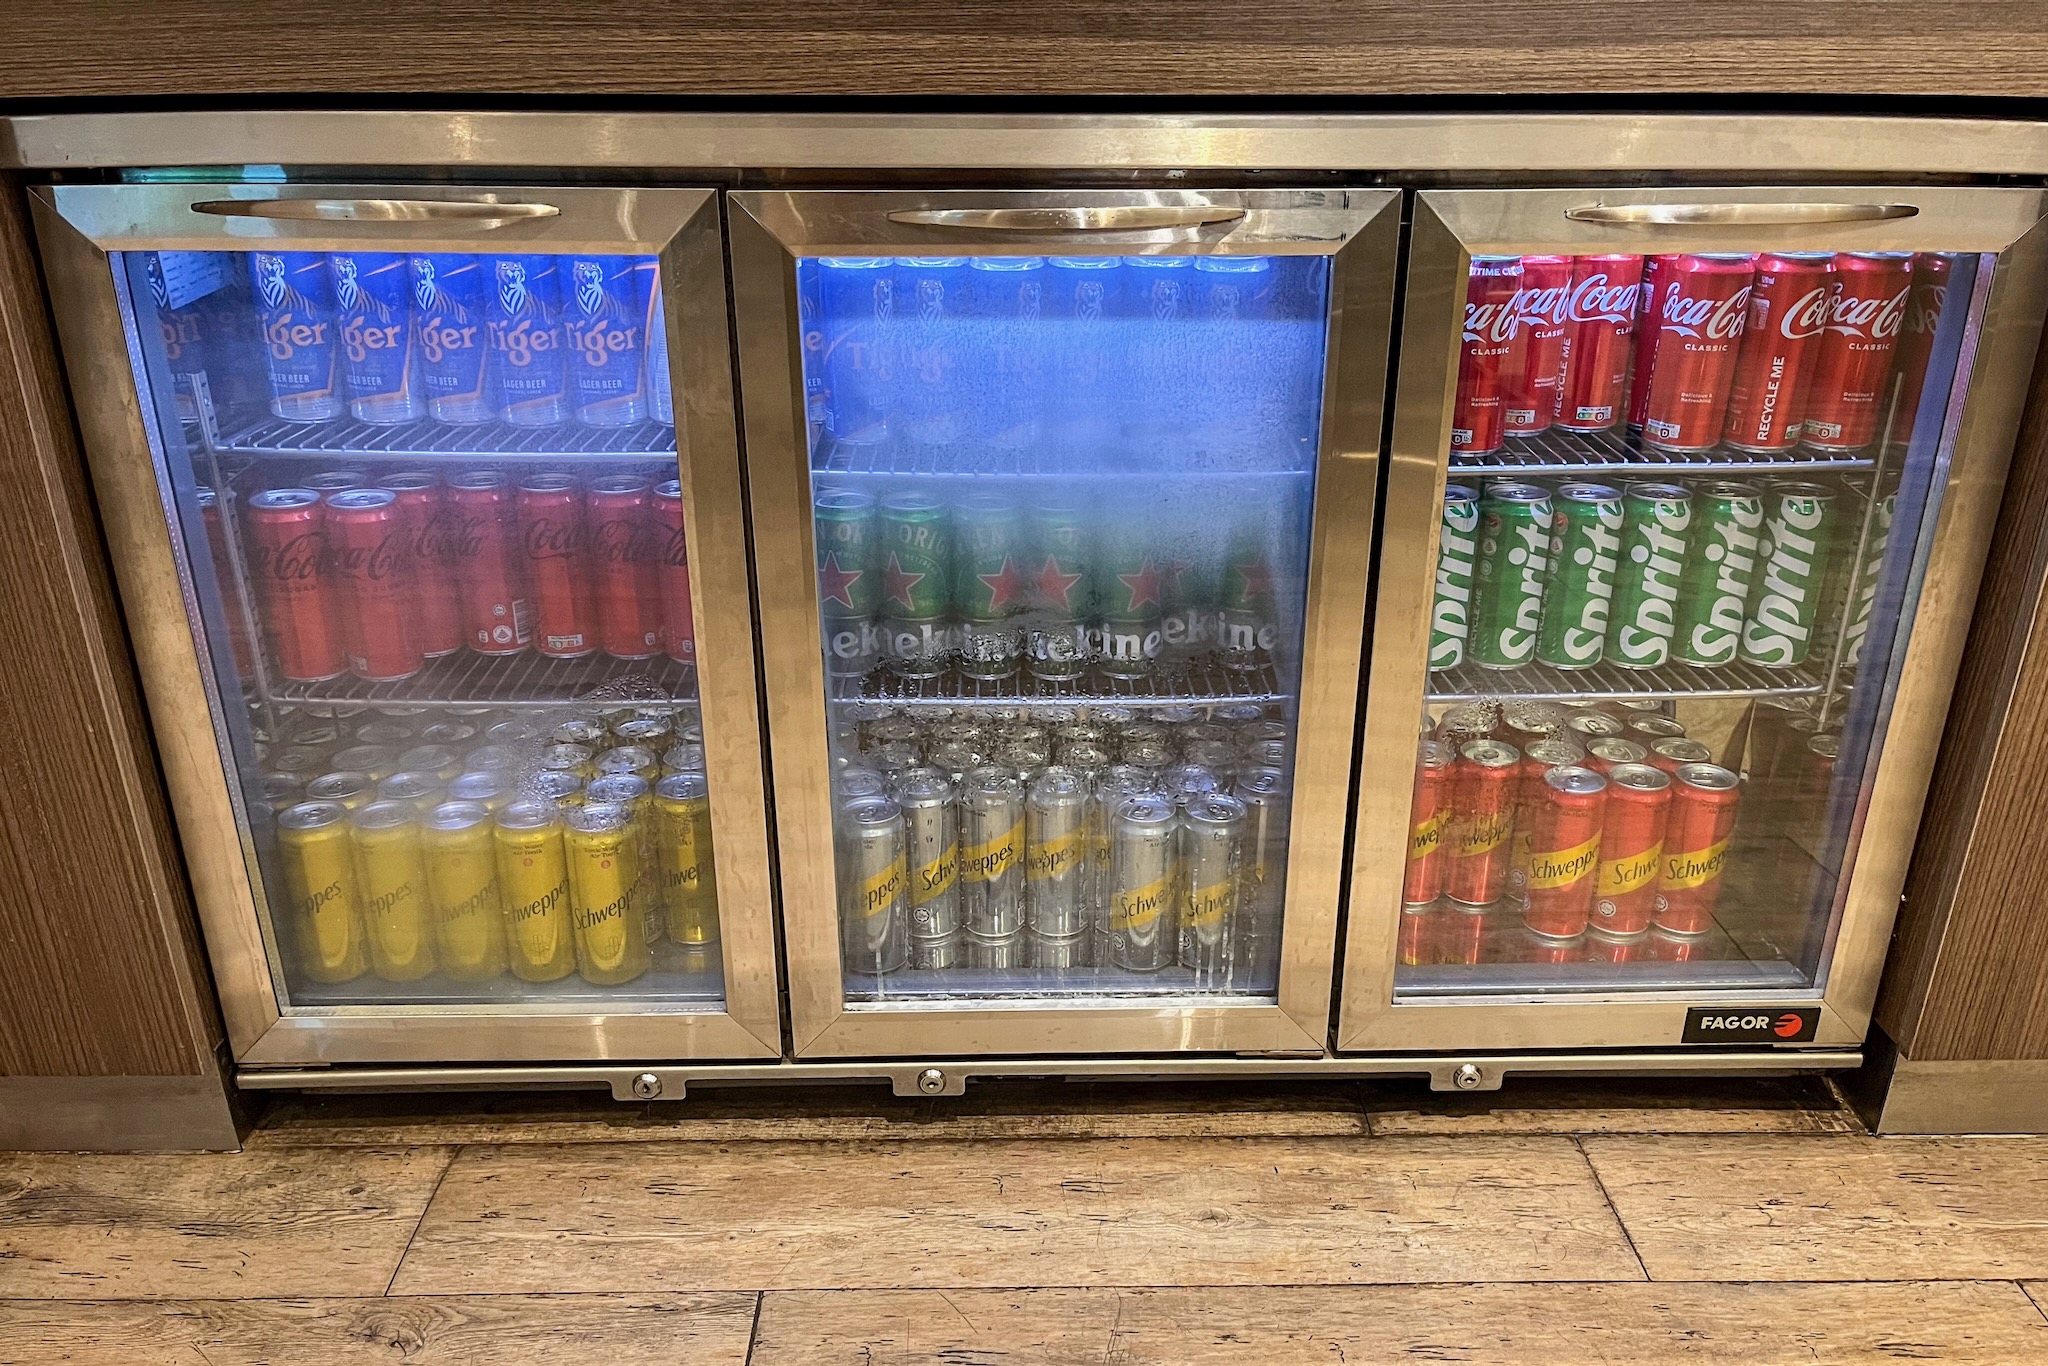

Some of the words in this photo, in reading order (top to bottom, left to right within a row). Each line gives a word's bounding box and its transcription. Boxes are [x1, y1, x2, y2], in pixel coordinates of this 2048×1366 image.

[526, 379, 547, 389] BEER
[602, 379, 623, 389] BEER
[1471, 347, 1510, 355] CLASSIC
[1554, 360, 1568, 418] RECYCLE
[1561, 338, 1572, 359] ME
[1684, 343, 1729, 352] CLASSIC
[1848, 342, 1891, 351] CLASSIC
[1757, 380, 1779, 440] RECYCLE
[1771, 356, 1785, 378] ME
[1499, 500, 1554, 663] Sprite
[1563, 500, 1624, 662] Sprite
[1619, 501, 1691, 665] Sprite
[1691, 499, 1764, 662] Sprite
[1743, 498, 1823, 665] Sprite
[1700, 1015, 1769, 1031] FAGOR
